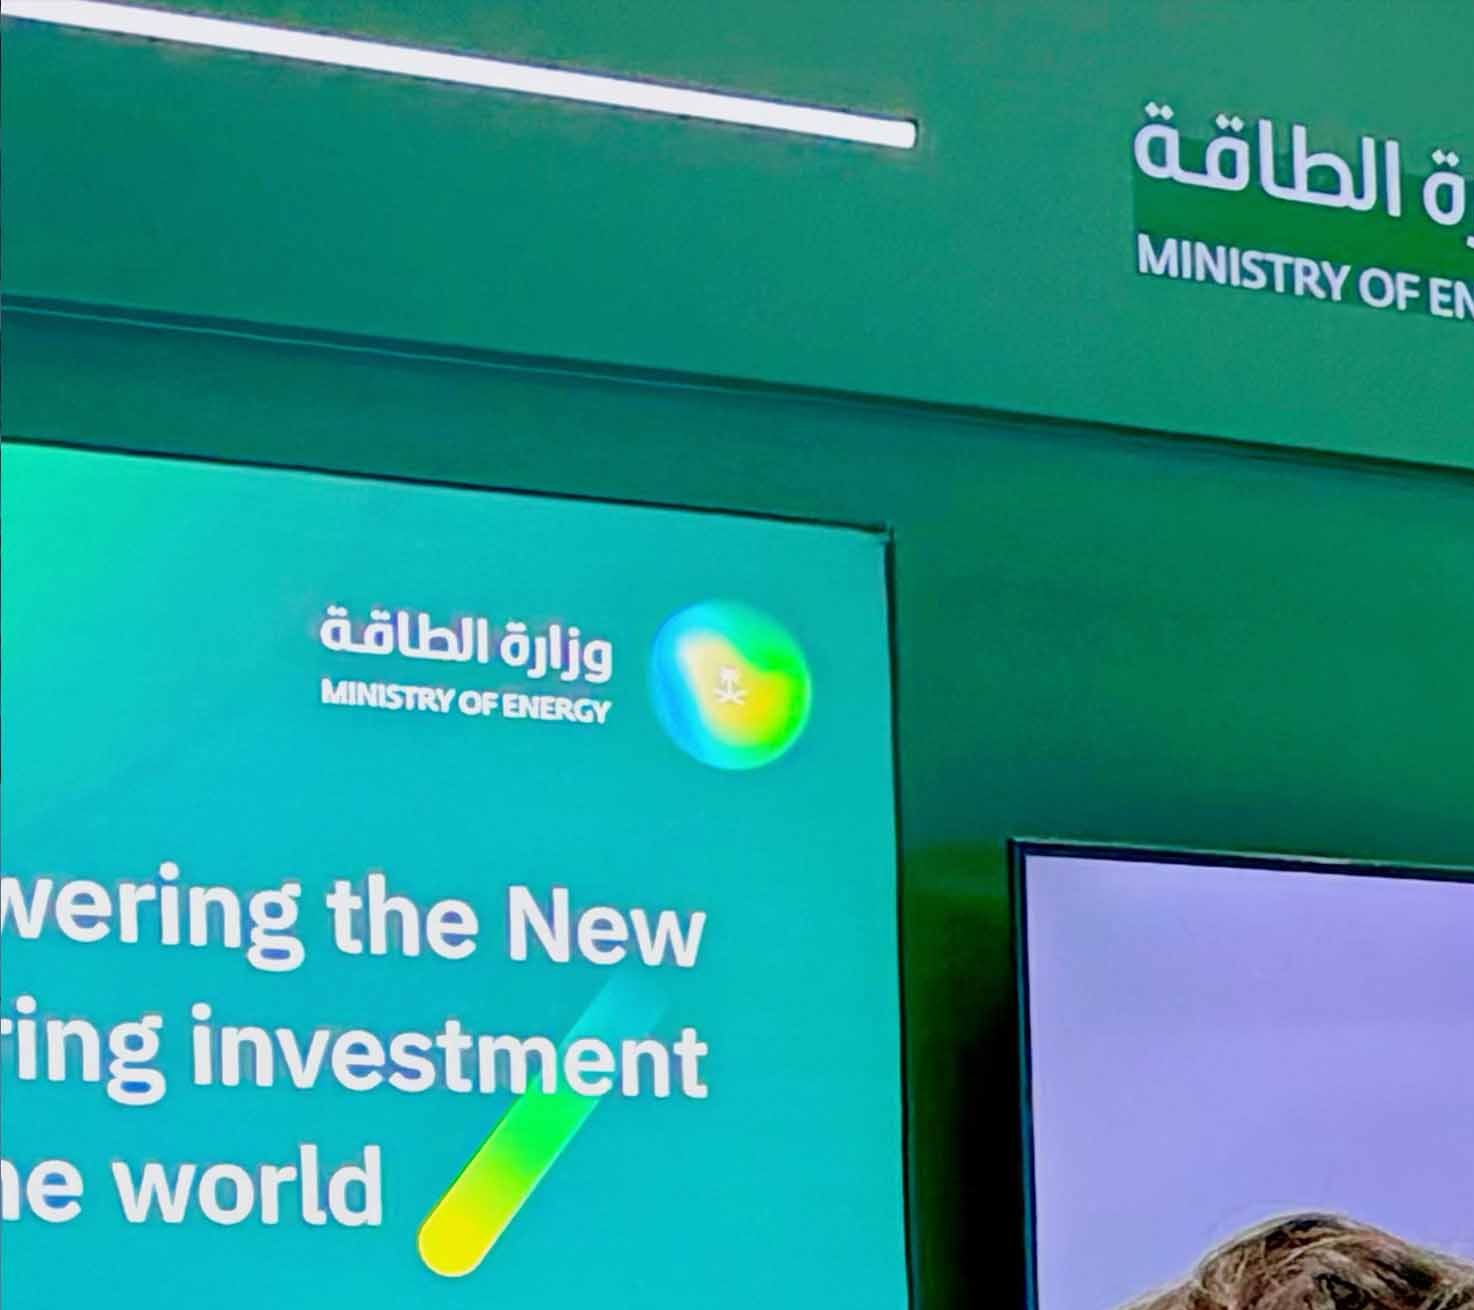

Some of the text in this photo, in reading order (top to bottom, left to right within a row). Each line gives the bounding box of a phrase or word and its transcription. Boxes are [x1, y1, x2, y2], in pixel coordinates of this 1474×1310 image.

[1134, 101, 1402, 218] الطاقة
[1136, 232, 1351, 302] MINISTRY
[1358, 266, 1421, 312] OF
[319, 605, 614, 684] وزارة الطاقة
[320, 676, 612, 725] MINISTRY OF ENERGY
[326, 871, 480, 958] the
[506, 884, 707, 968] New
[190, 1002, 710, 1099] investment
[111, 1142, 383, 1227] world
